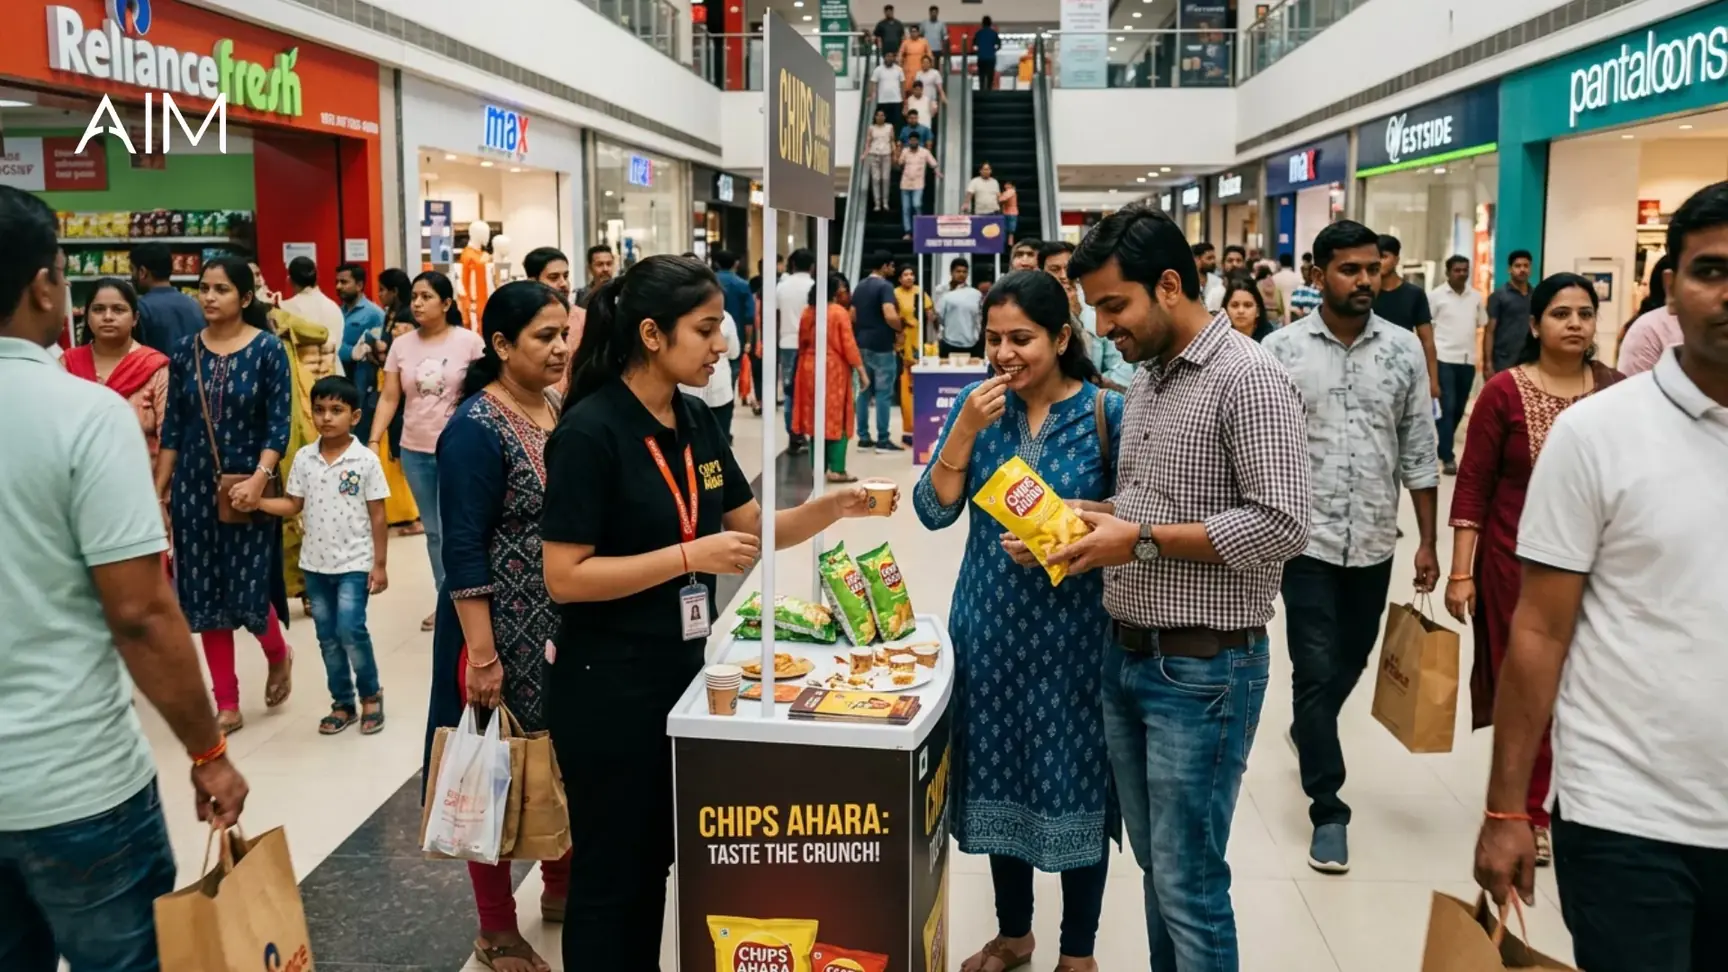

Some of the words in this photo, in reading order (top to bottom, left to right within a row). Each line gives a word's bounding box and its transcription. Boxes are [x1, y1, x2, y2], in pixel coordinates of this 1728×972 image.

[1569, 26, 1728, 128] pantaloons
[485, 105, 529, 154] max
[780, 67, 813, 169] CHIPS
[699, 805, 780, 838] CHIPS
[786, 803, 889, 836] AHARA:
[707, 843, 761, 865] TASTE
[764, 843, 799, 864] THE
[802, 841, 881, 864] CRUNCH!
